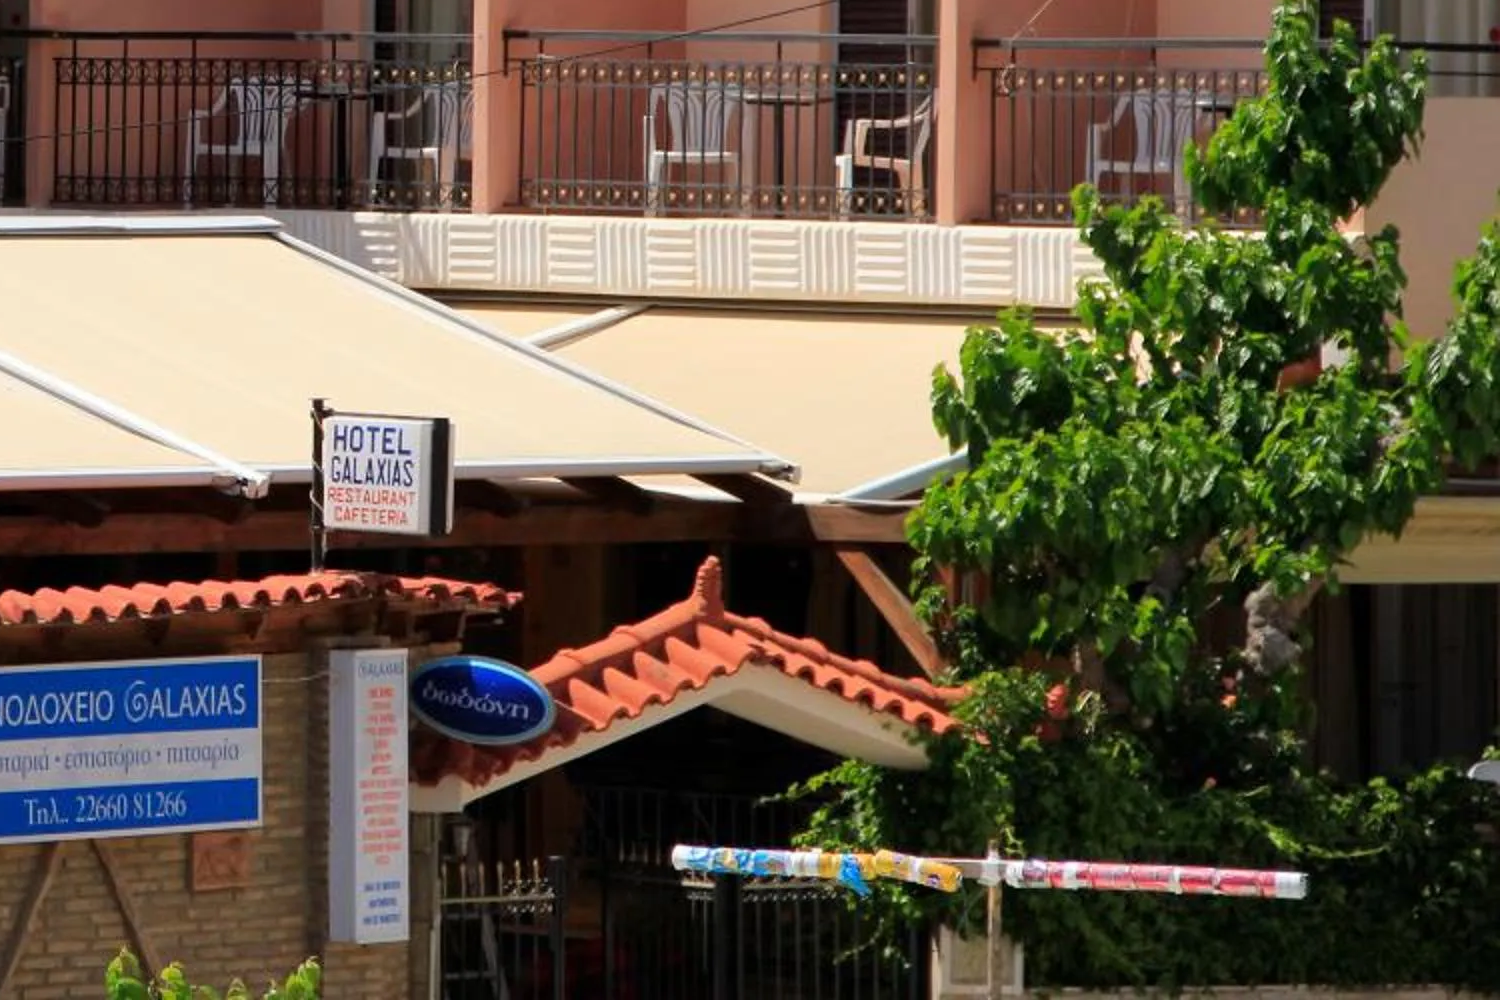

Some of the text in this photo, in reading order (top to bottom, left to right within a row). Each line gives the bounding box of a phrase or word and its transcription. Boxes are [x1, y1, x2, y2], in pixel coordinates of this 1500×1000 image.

[333, 424, 412, 456] HOTEL
[330, 456, 414, 487] GALAXIAS
[327, 486, 417, 506] RESTAURANT
[333, 506, 409, 525] CAFETERIA
[123, 680, 247, 723] GALAXIAS
[75, 793, 129, 823] 22660
[133, 790, 188, 819] 81266
